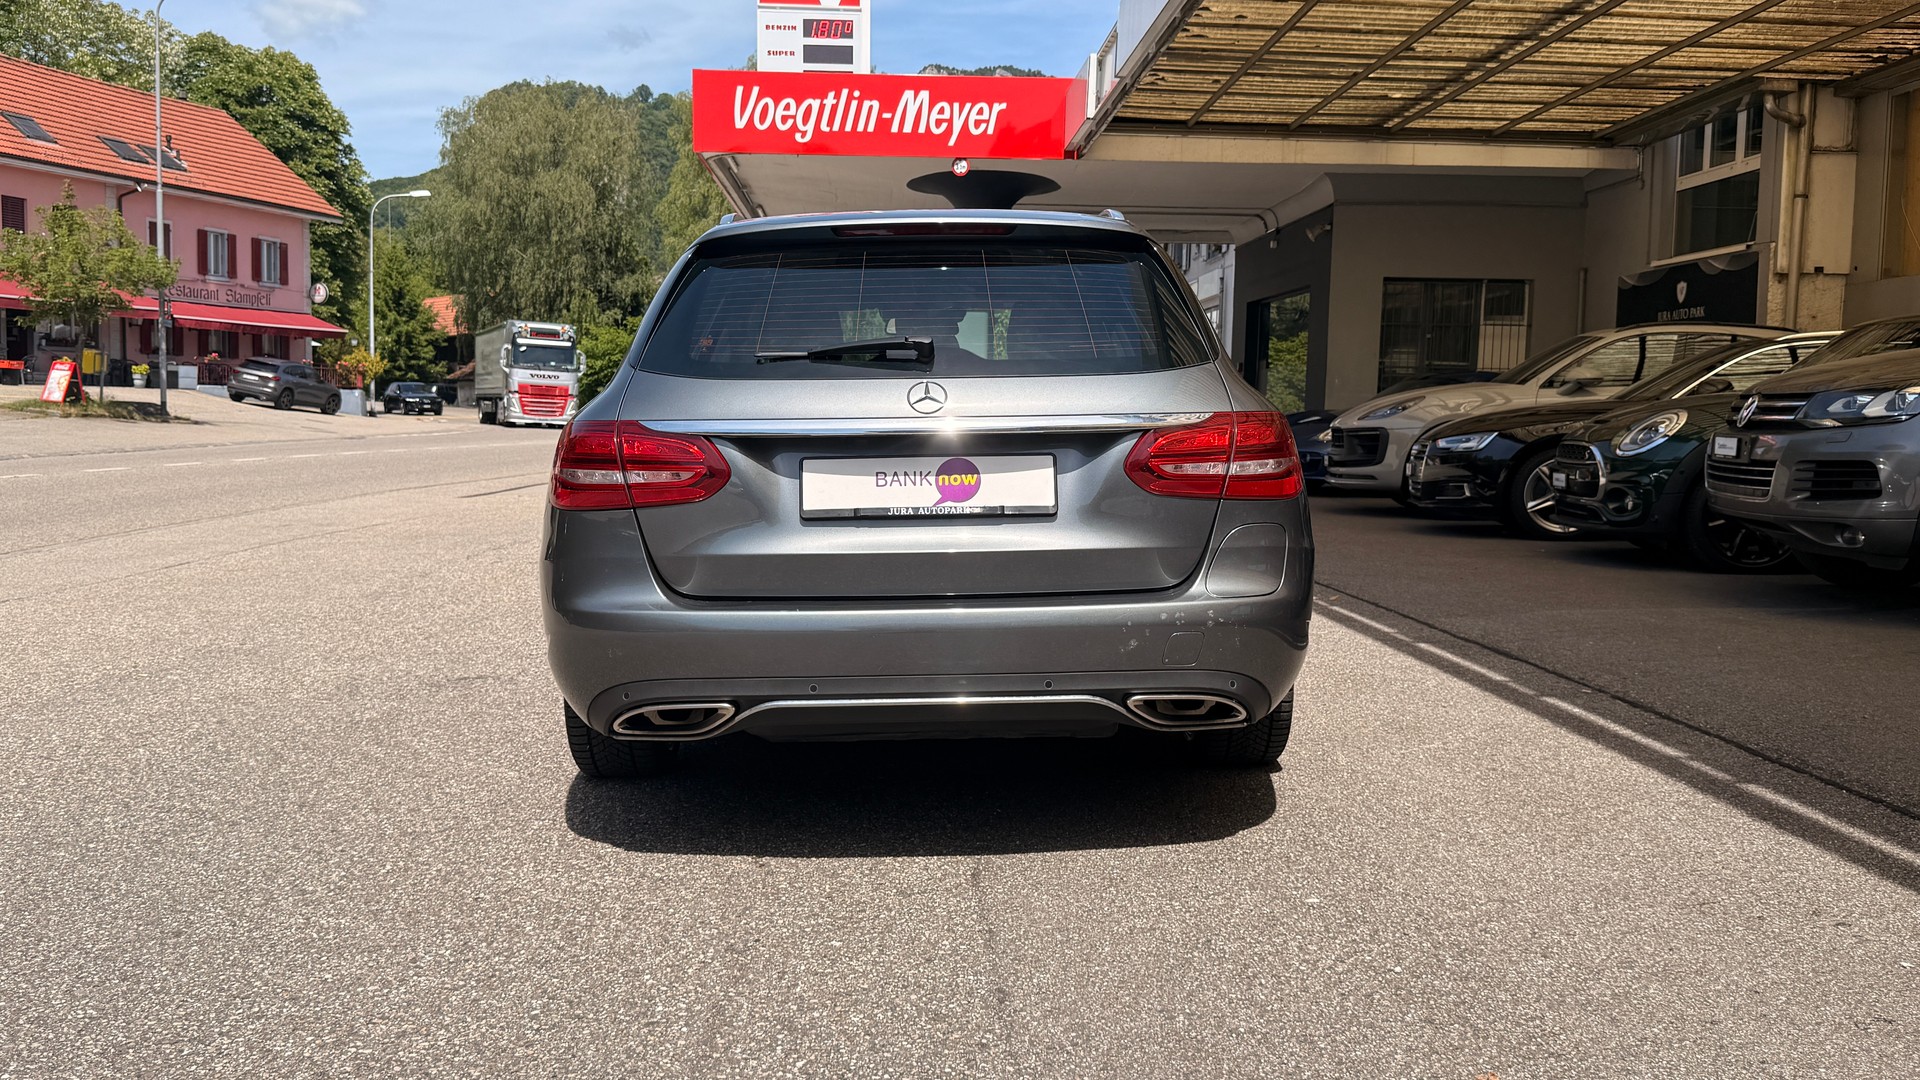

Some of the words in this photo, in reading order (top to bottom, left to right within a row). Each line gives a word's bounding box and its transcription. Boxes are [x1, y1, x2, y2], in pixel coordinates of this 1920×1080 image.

[734, 85, 1007, 146] Voegtlin-Meyer
[1672, 308, 1689, 320] AUTO
[1690, 305, 1706, 318] PARK
[875, 471, 933, 487] BANK
[938, 474, 978, 486] now
[887, 507, 914, 515] JURA
